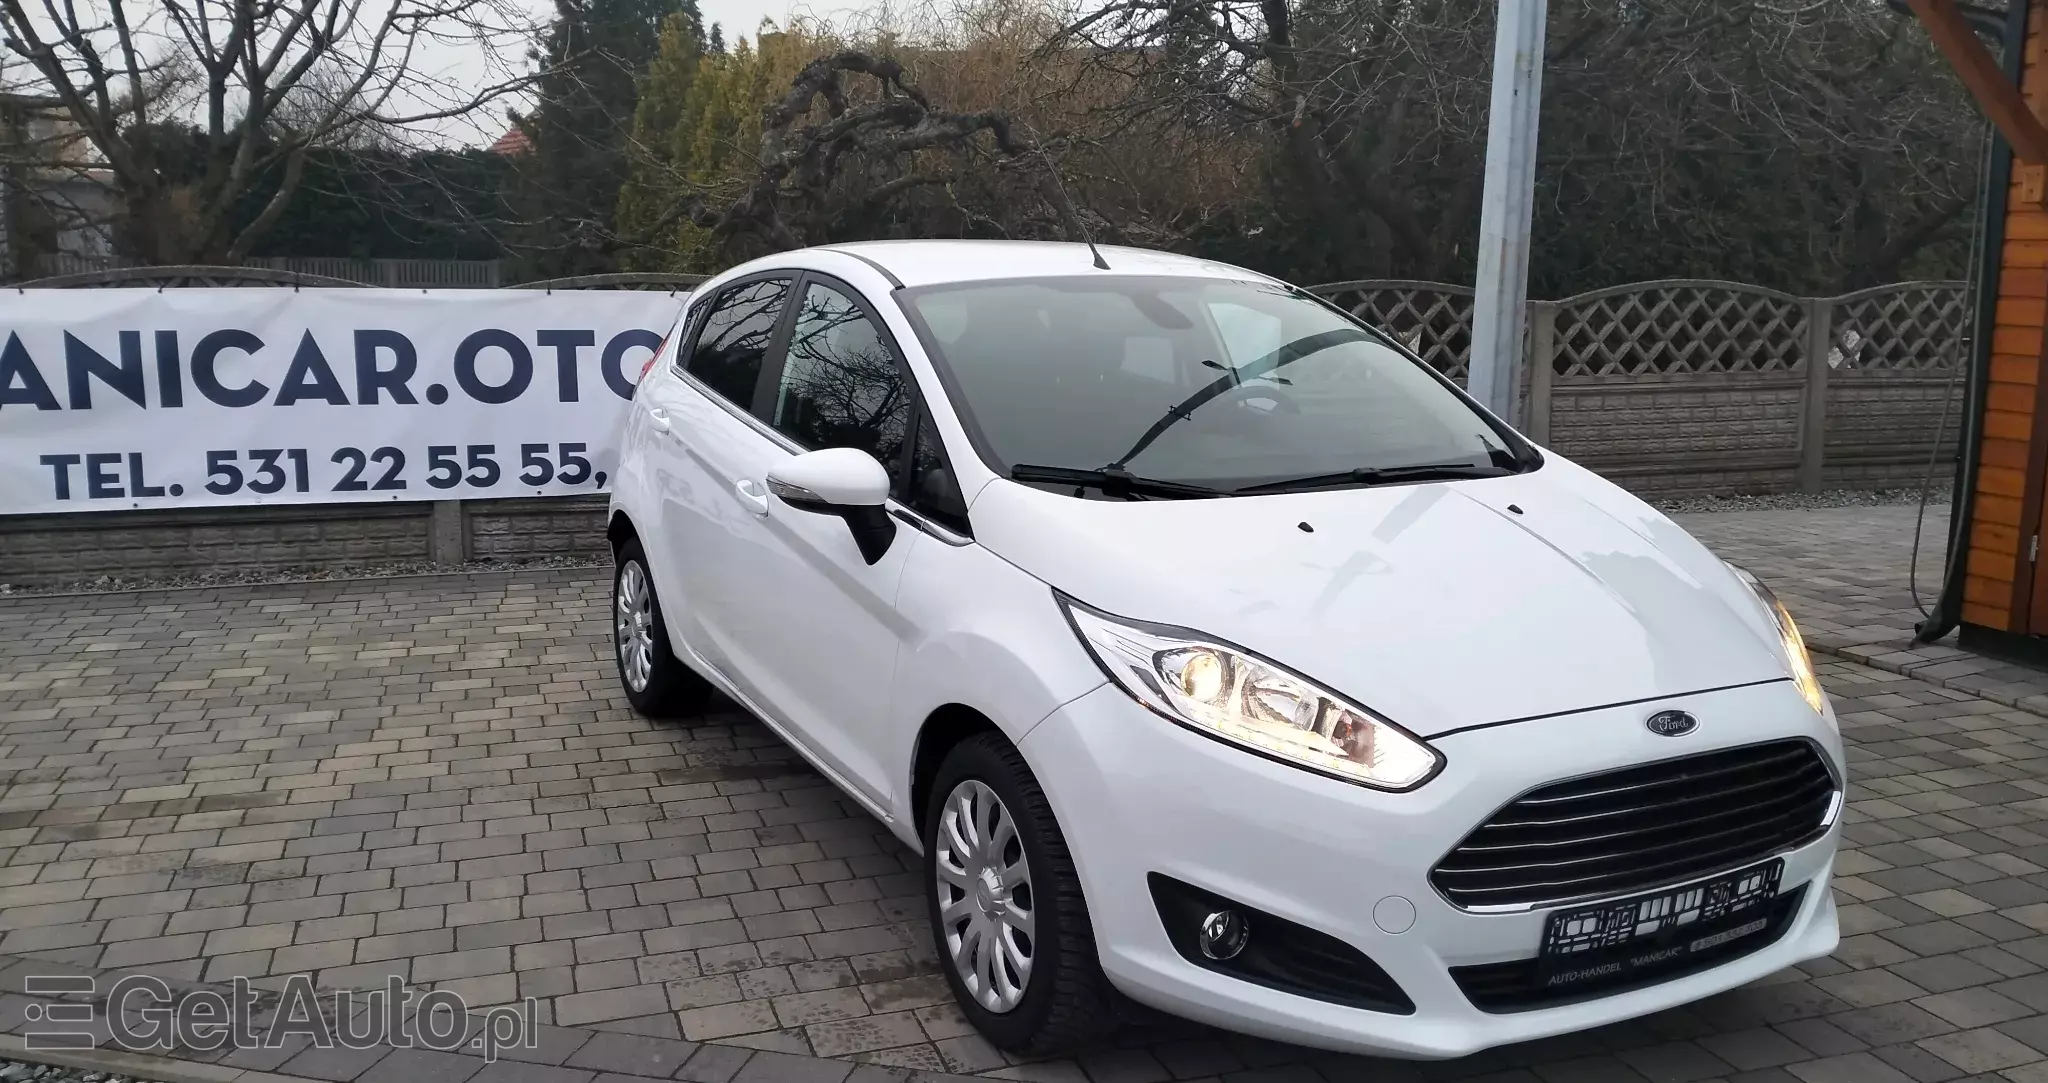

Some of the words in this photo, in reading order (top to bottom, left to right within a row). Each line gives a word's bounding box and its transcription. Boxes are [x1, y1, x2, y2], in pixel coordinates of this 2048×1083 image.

[40, 452, 184, 501] TEL.
[205, 447, 310, 496] 531
[331, 446, 407, 492] 22
[426, 444, 501, 490] 55
[519, 442, 608, 490] 55,
[1658, 715, 1689, 732] Ford
[1548, 962, 1622, 986] AUTO-HANDEL
